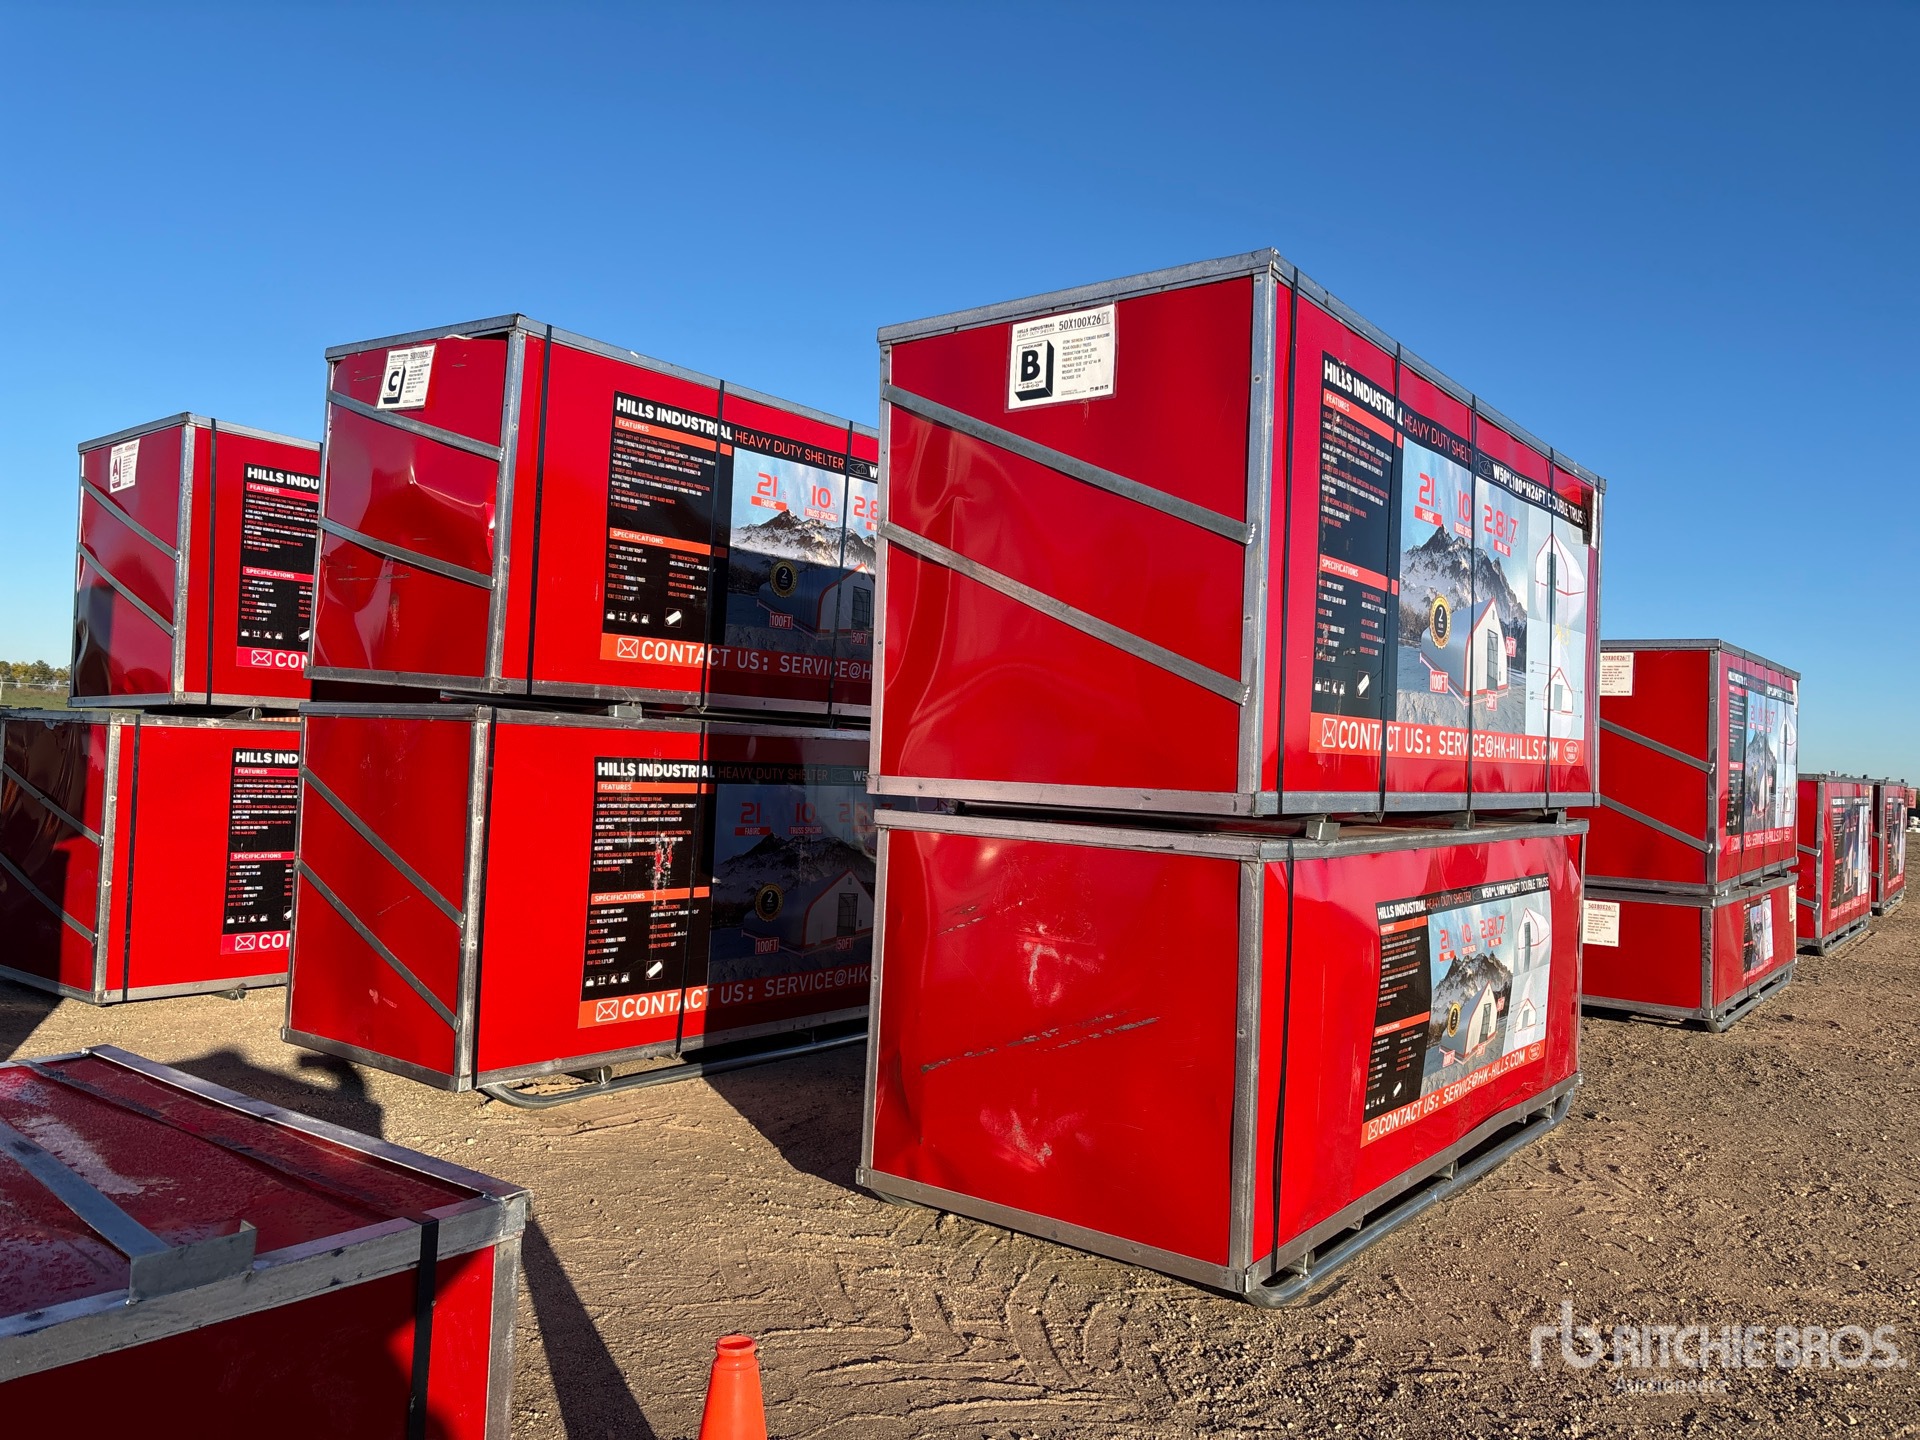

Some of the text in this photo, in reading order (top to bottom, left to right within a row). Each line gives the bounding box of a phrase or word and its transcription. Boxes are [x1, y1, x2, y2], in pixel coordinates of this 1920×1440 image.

[1021, 350, 1040, 382] B
[388, 370, 400, 392] C
[1326, 393, 1350, 412] FEATURES
[616, 396, 654, 419] HILLS
[656, 408, 732, 440] INDUSTRIAL
[735, 430, 770, 450] HEAVY
[773, 440, 802, 458] DUTY
[804, 448, 844, 470] SHELTER
[618, 420, 650, 433] FEATURES
[1324, 360, 1352, 392] HILLS
[1354, 376, 1403, 426] INDUSTRIL
[1404, 412, 1430, 441] HEAVY
[1432, 428, 1450, 452] DUTY
[1568, 504, 1587, 526] TRUSS
[112, 458, 118, 477] A
[247, 467, 284, 484] HILLS
[249, 484, 280, 494] FEATURES
[757, 472, 778, 497] 21
[1418, 472, 1435, 507] 21
[812, 486, 832, 508] 10
[1458, 490, 1472, 522] 10
[613, 530, 664, 544] SPECIFICATIONS
[246, 568, 294, 579] SPECIFICATIONS
[782, 568, 787, 579] 2
[1322, 558, 1358, 577] SPECIFICATIONS
[771, 615, 792, 628] 100FT
[1438, 607, 1444, 622] 2
[852, 633, 867, 644] 50FT
[642, 641, 731, 667] CONTACT
[737, 652, 768, 670] US:
[1338, 720, 1558, 761] CONTCT US: SERVCE@HK-HILLS.CM
[235, 752, 272, 764] HILLS
[598, 762, 636, 776] HILLS
[638, 764, 714, 778] INDUSTRIAL
[718, 766, 754, 778] HEAVY
[756, 768, 784, 780] DUTY
[788, 769, 828, 781] SHELTER
[740, 804, 760, 824] 21
[796, 803, 816, 823] 10
[234, 852, 282, 860] SPECIFICATIONS
[594, 893, 646, 902] SPECIFICATIONS
[768, 892, 773, 902] 2
[1378, 905, 1394, 920] HILLS
[1395, 900, 1426, 917] INDUSTRIAL
[1440, 894, 1454, 907] DUTY
[1452, 891, 1472, 905] SHELTER
[1520, 880, 1536, 892] DOUBLE
[1536, 876, 1548, 888] TRUSS
[757, 940, 778, 953] 100FT
[838, 938, 853, 950] 50FT
[1440, 930, 1449, 950] 21
[622, 988, 714, 1019] CONTACT
[720, 984, 754, 1004] US:
[1379, 1101, 1420, 1134] CONTACT
[1423, 1094, 1440, 1113] US:
[1443, 1052, 1525, 1104] SERVICE@HK-HILLS.COM
